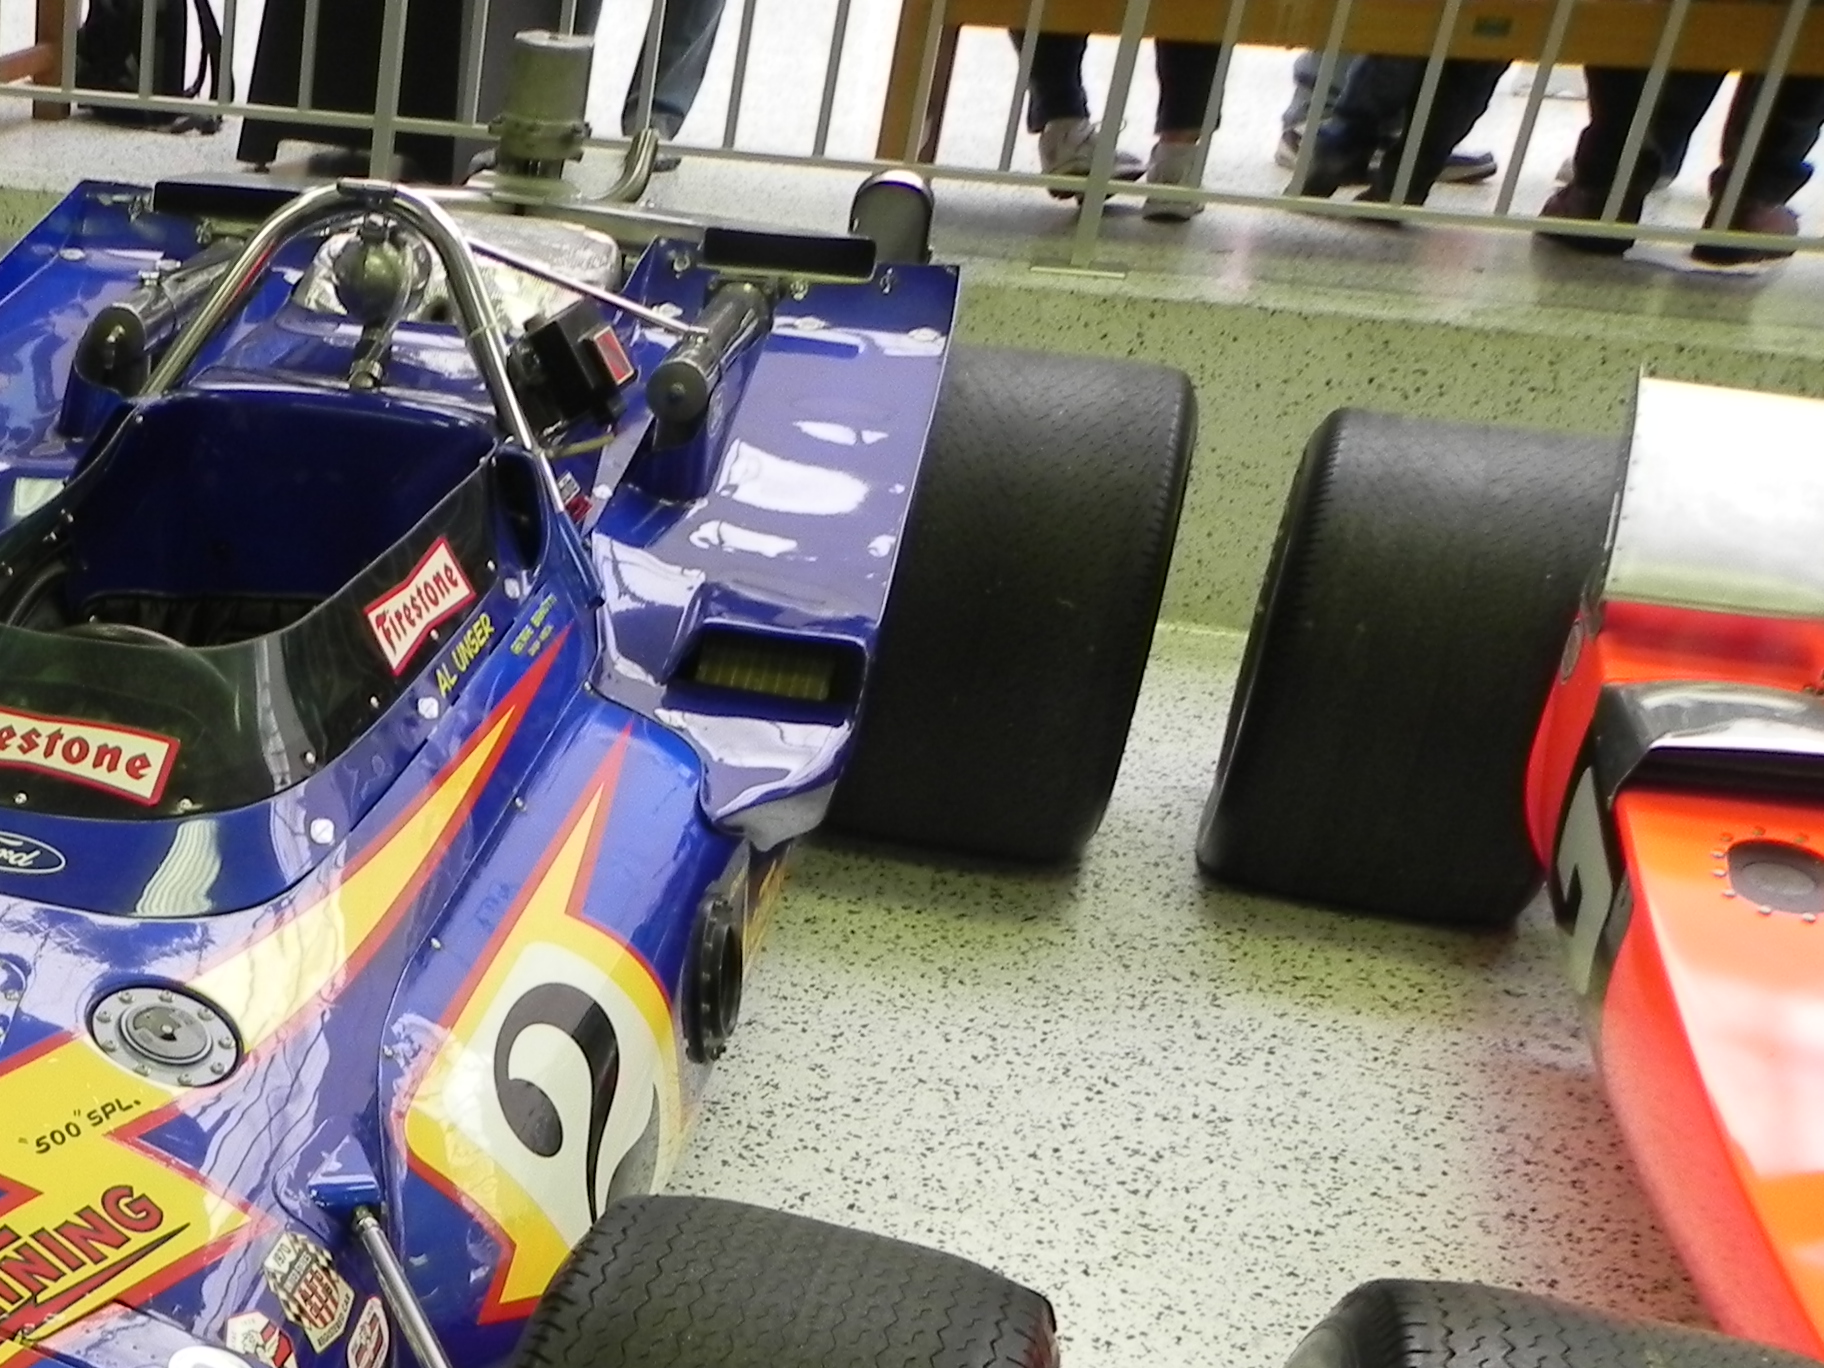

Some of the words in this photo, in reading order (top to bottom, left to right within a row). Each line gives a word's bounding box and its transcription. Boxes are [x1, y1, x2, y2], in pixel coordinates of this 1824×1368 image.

[374, 562, 460, 657] Firestone
[434, 661, 459, 698] AL
[450, 611, 496, 673] UNSER
[85, 1097, 143, 1128] SPL.
[492, 980, 661, 1227] 2
